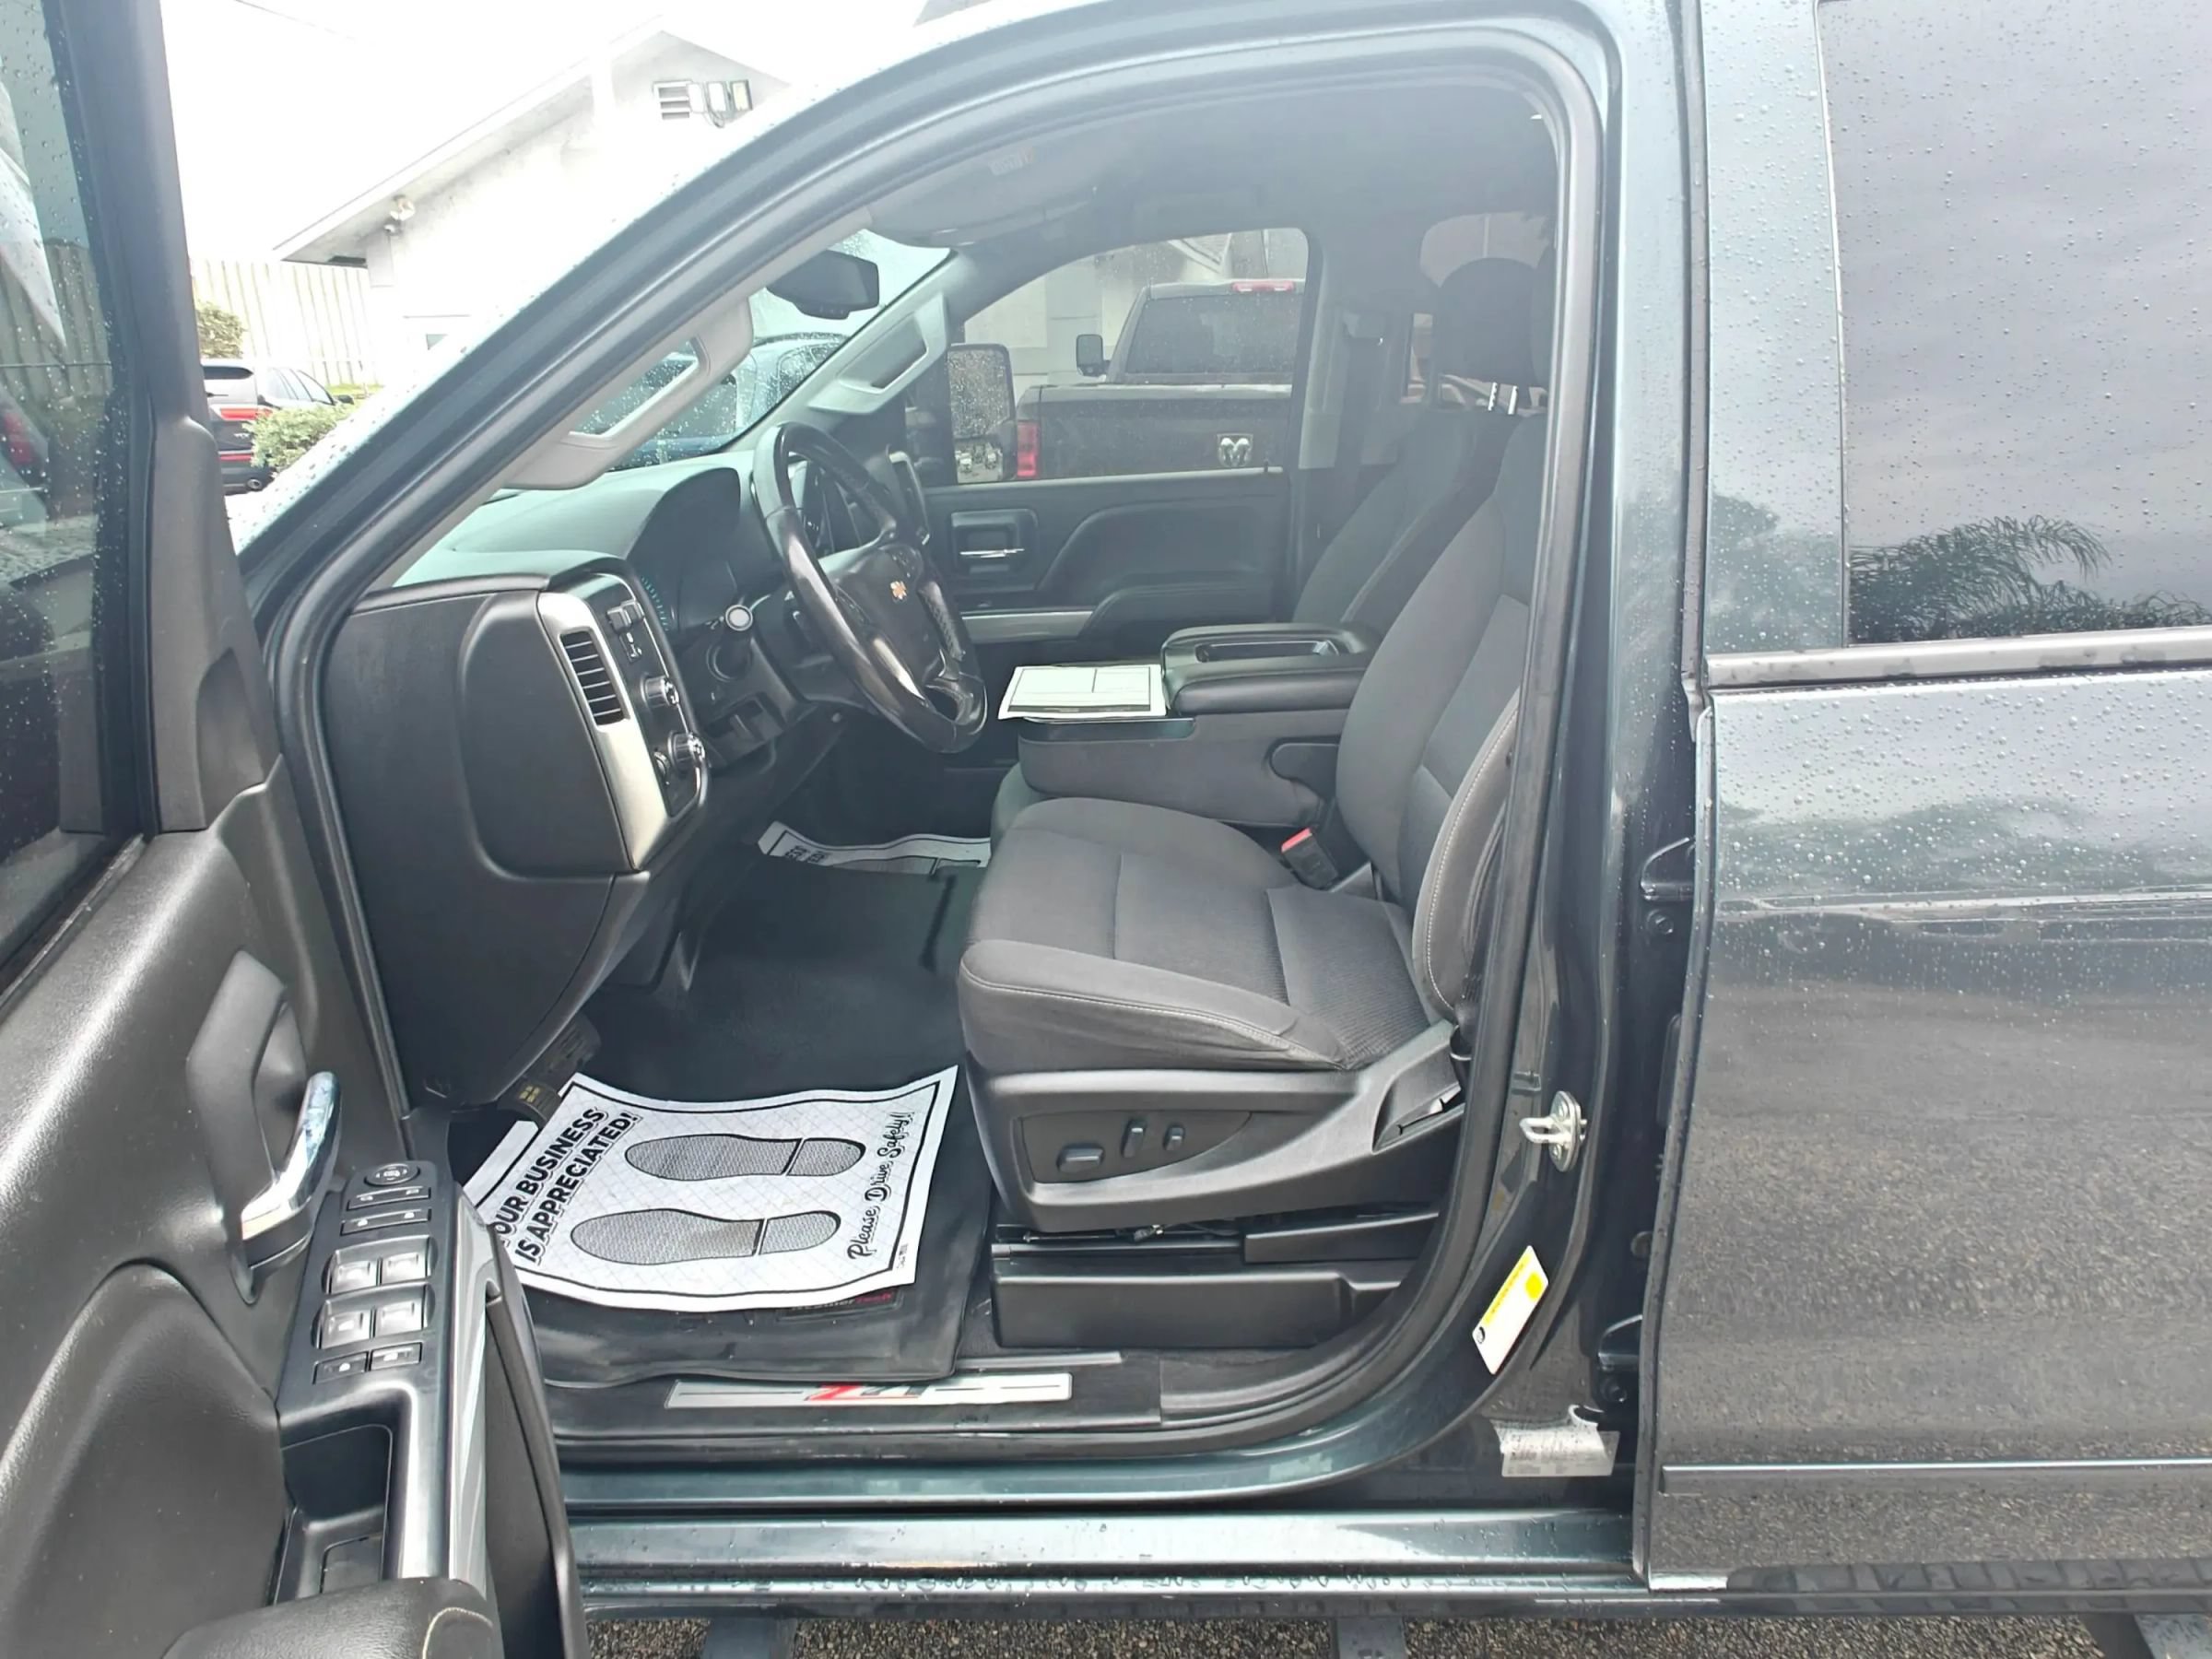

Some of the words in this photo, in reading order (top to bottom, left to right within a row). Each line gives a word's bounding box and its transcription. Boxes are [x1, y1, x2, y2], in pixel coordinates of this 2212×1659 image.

[491, 1194, 529, 1240] OUR
[514, 1107, 608, 1195] BUSINESS
[525, 1112, 640, 1241] APPRECIATED!
[847, 1205, 880, 1259] Please
[865, 1160, 893, 1202] Drive
[514, 1237, 544, 1264] IS
